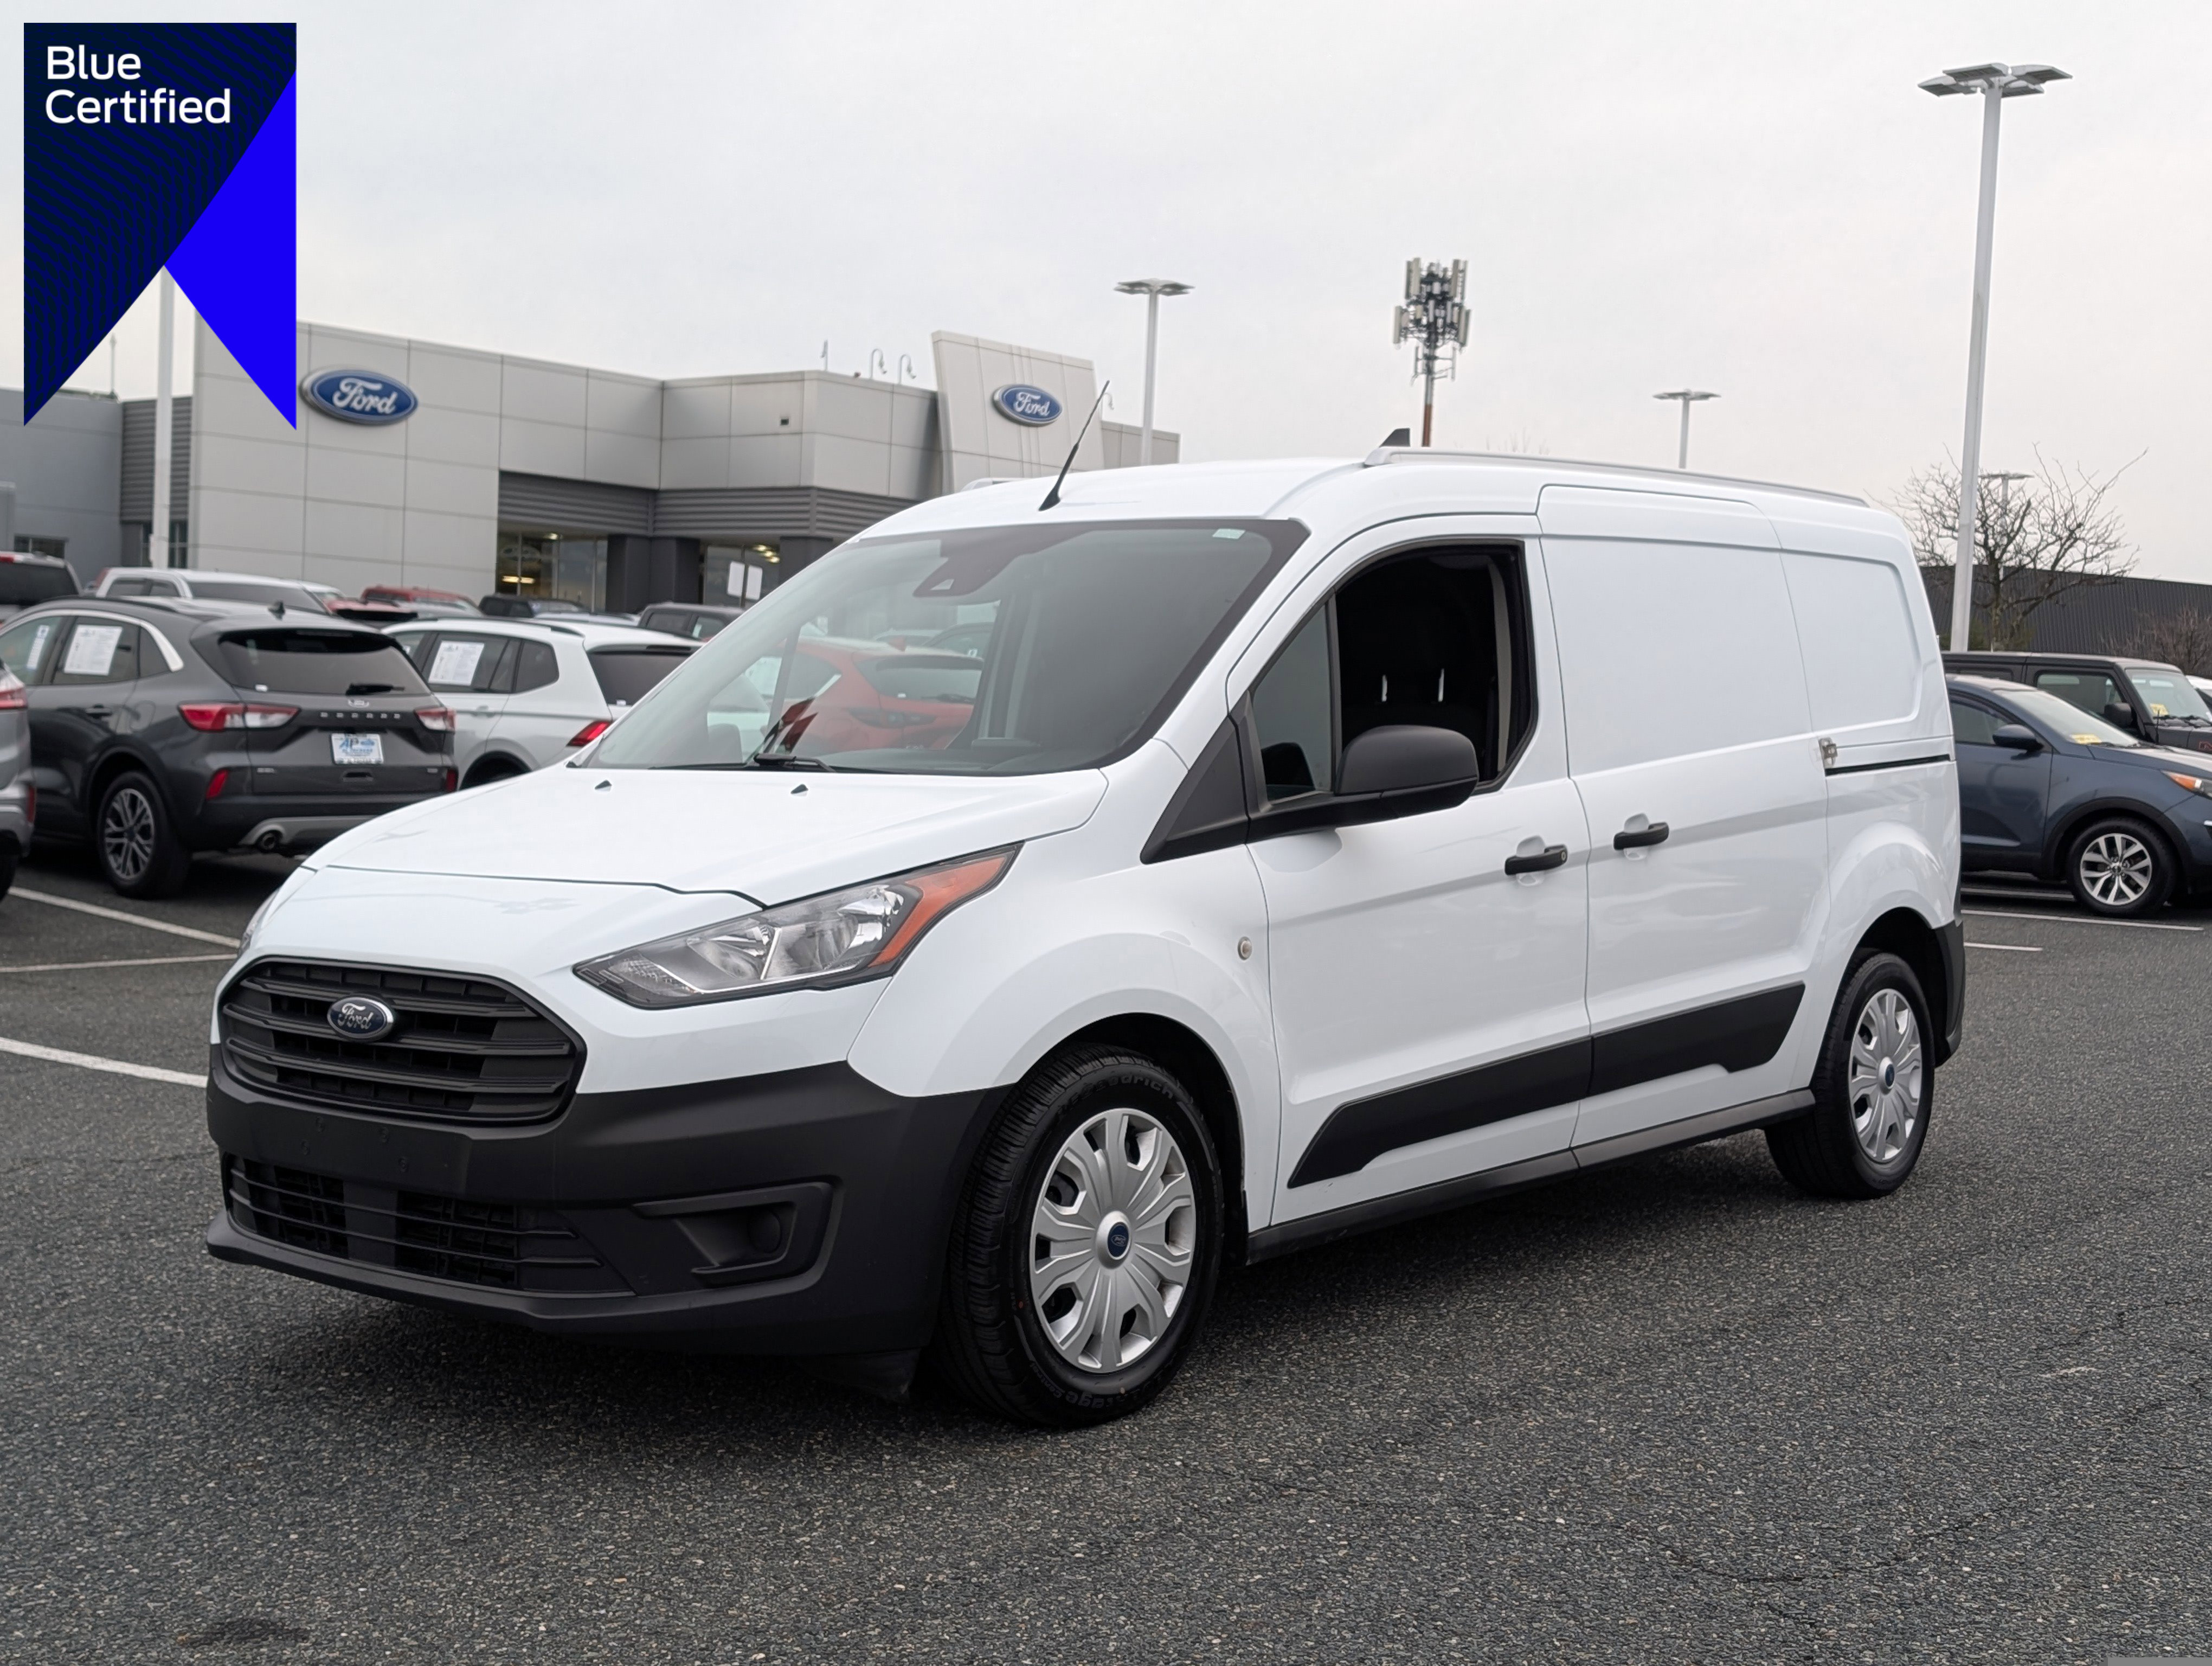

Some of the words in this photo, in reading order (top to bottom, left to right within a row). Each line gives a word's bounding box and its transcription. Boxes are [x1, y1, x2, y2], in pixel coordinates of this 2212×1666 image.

[332, 377, 398, 414] Ford
[1013, 392, 1051, 416] Ford
[337, 1003, 374, 1029] Ford
